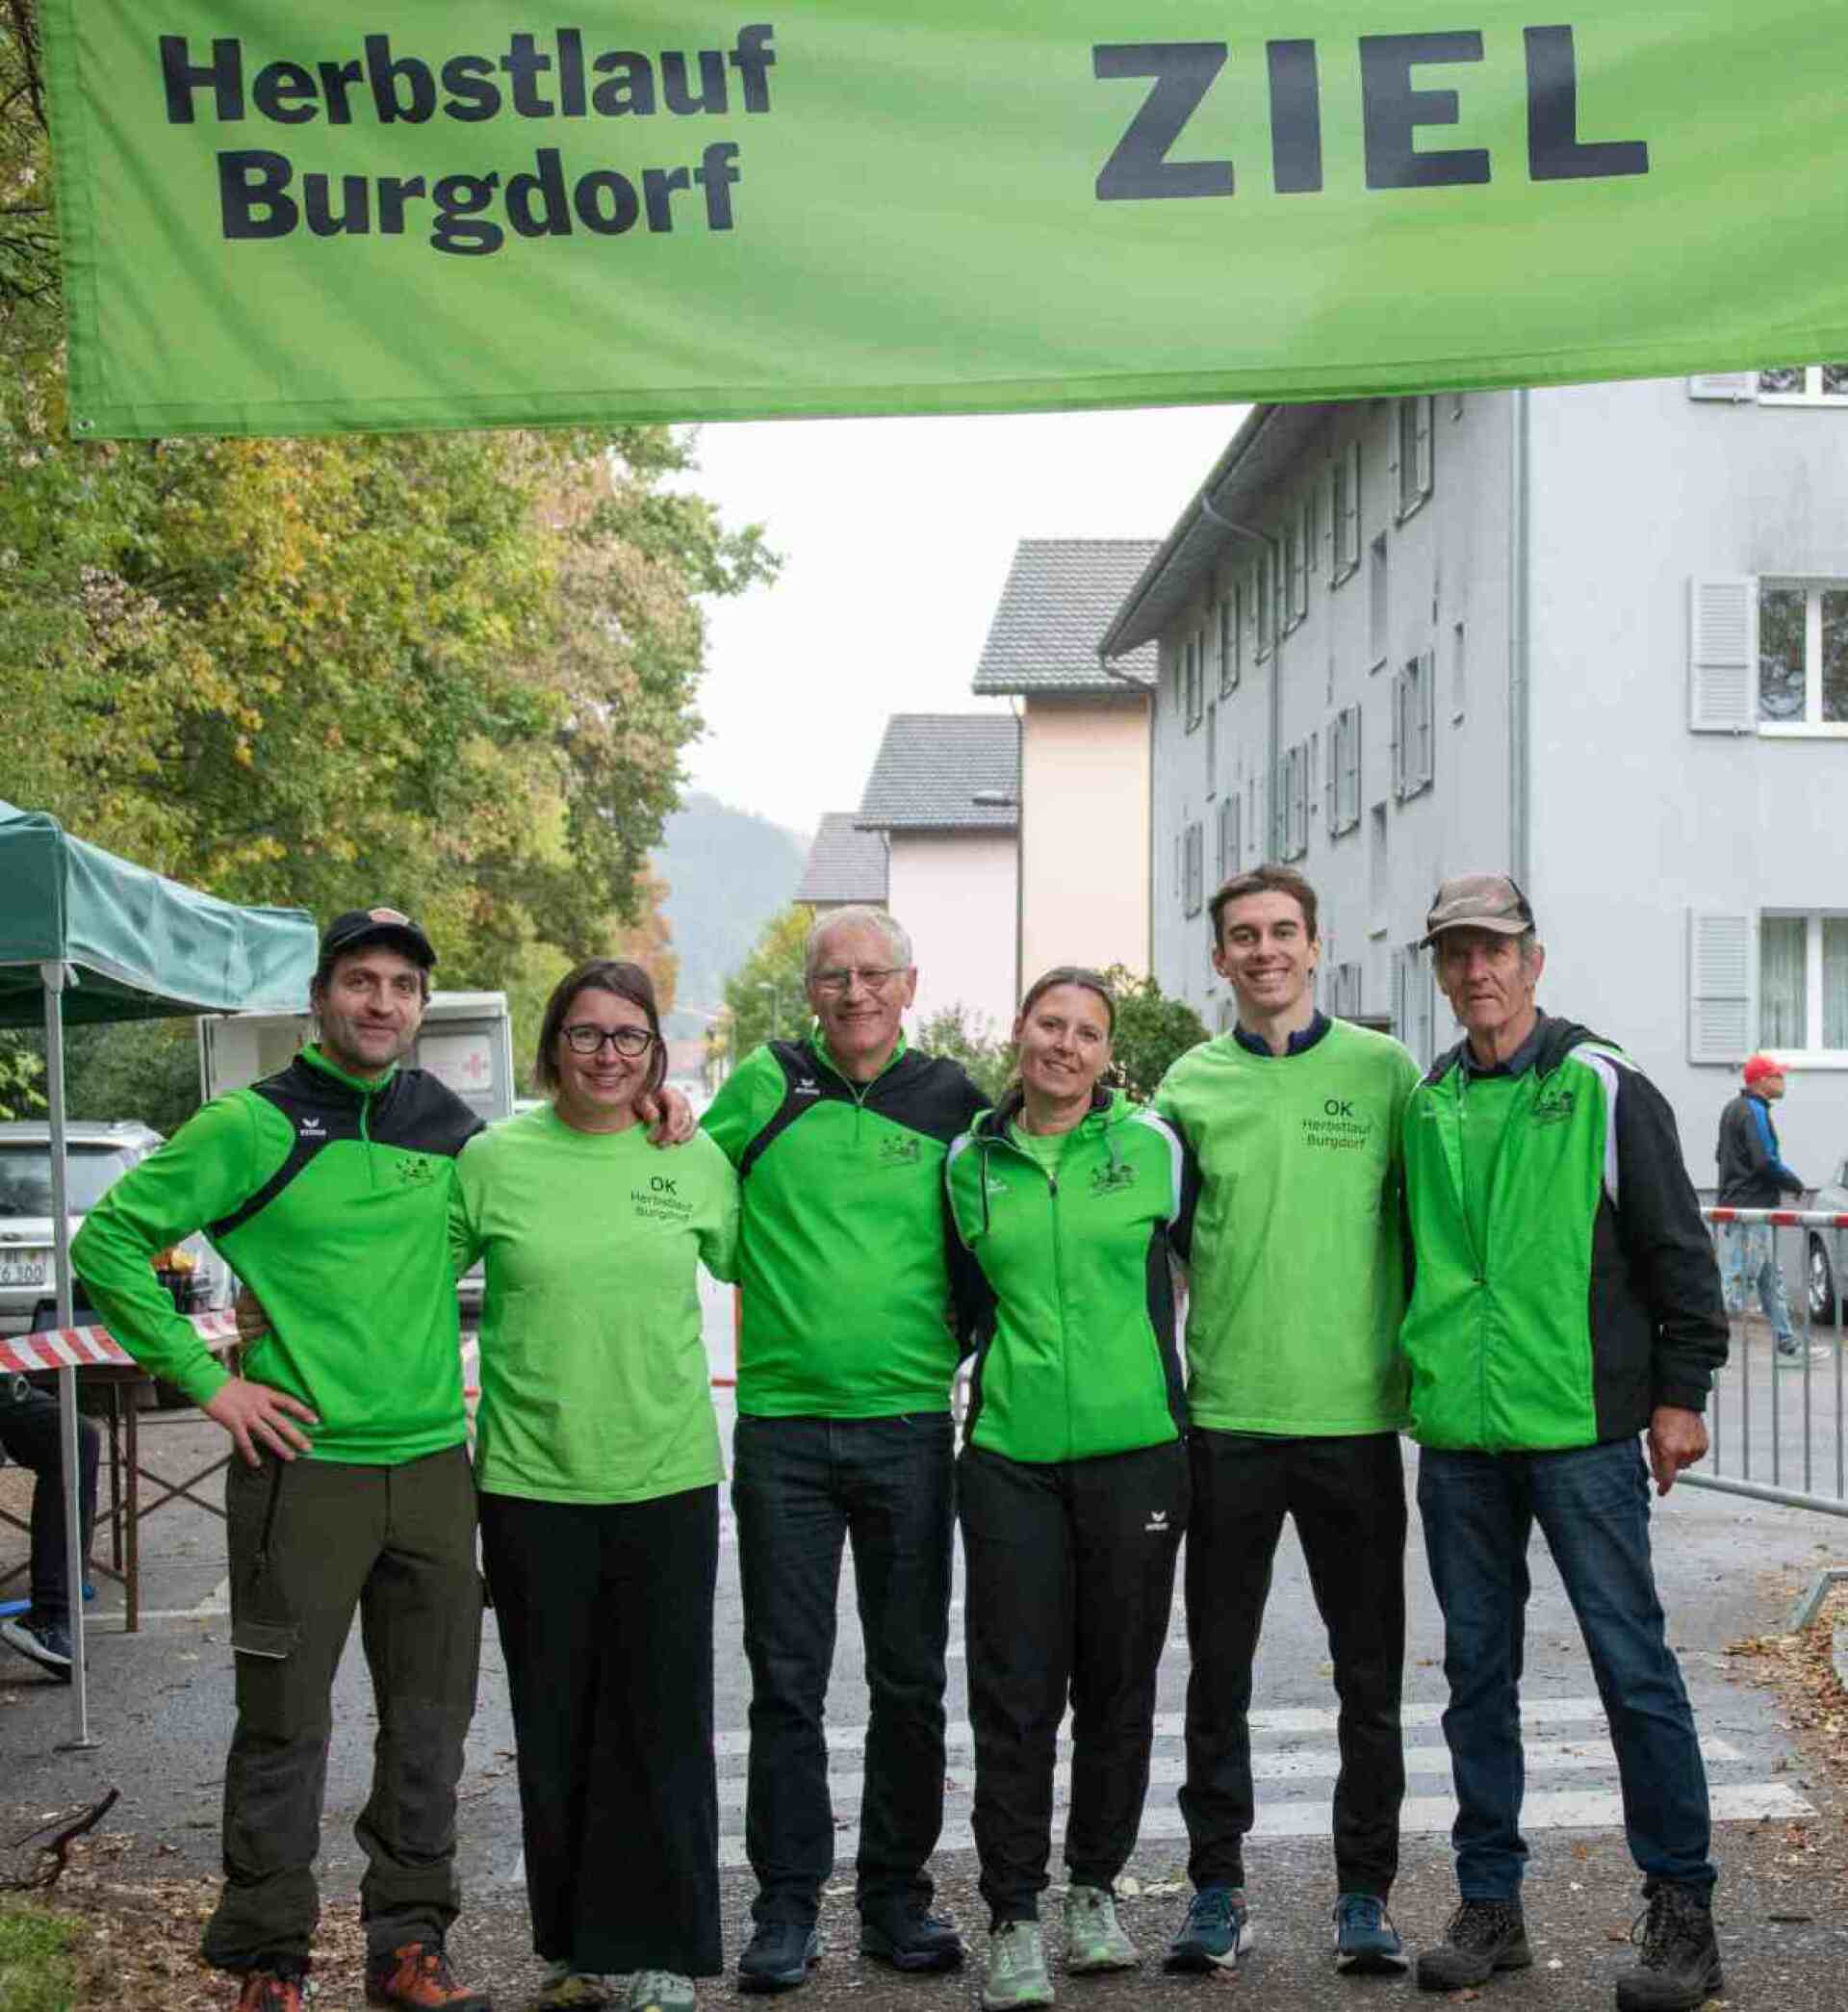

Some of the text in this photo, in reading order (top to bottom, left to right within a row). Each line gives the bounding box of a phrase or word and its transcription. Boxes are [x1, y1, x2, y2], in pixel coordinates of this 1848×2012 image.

[159, 24, 775, 125] Herbstlauf
[1092, 24, 1649, 200] ZIEL
[217, 142, 742, 257] Burgdorf
[1324, 1099, 1353, 1117] OK
[651, 1176, 677, 1195] OK
